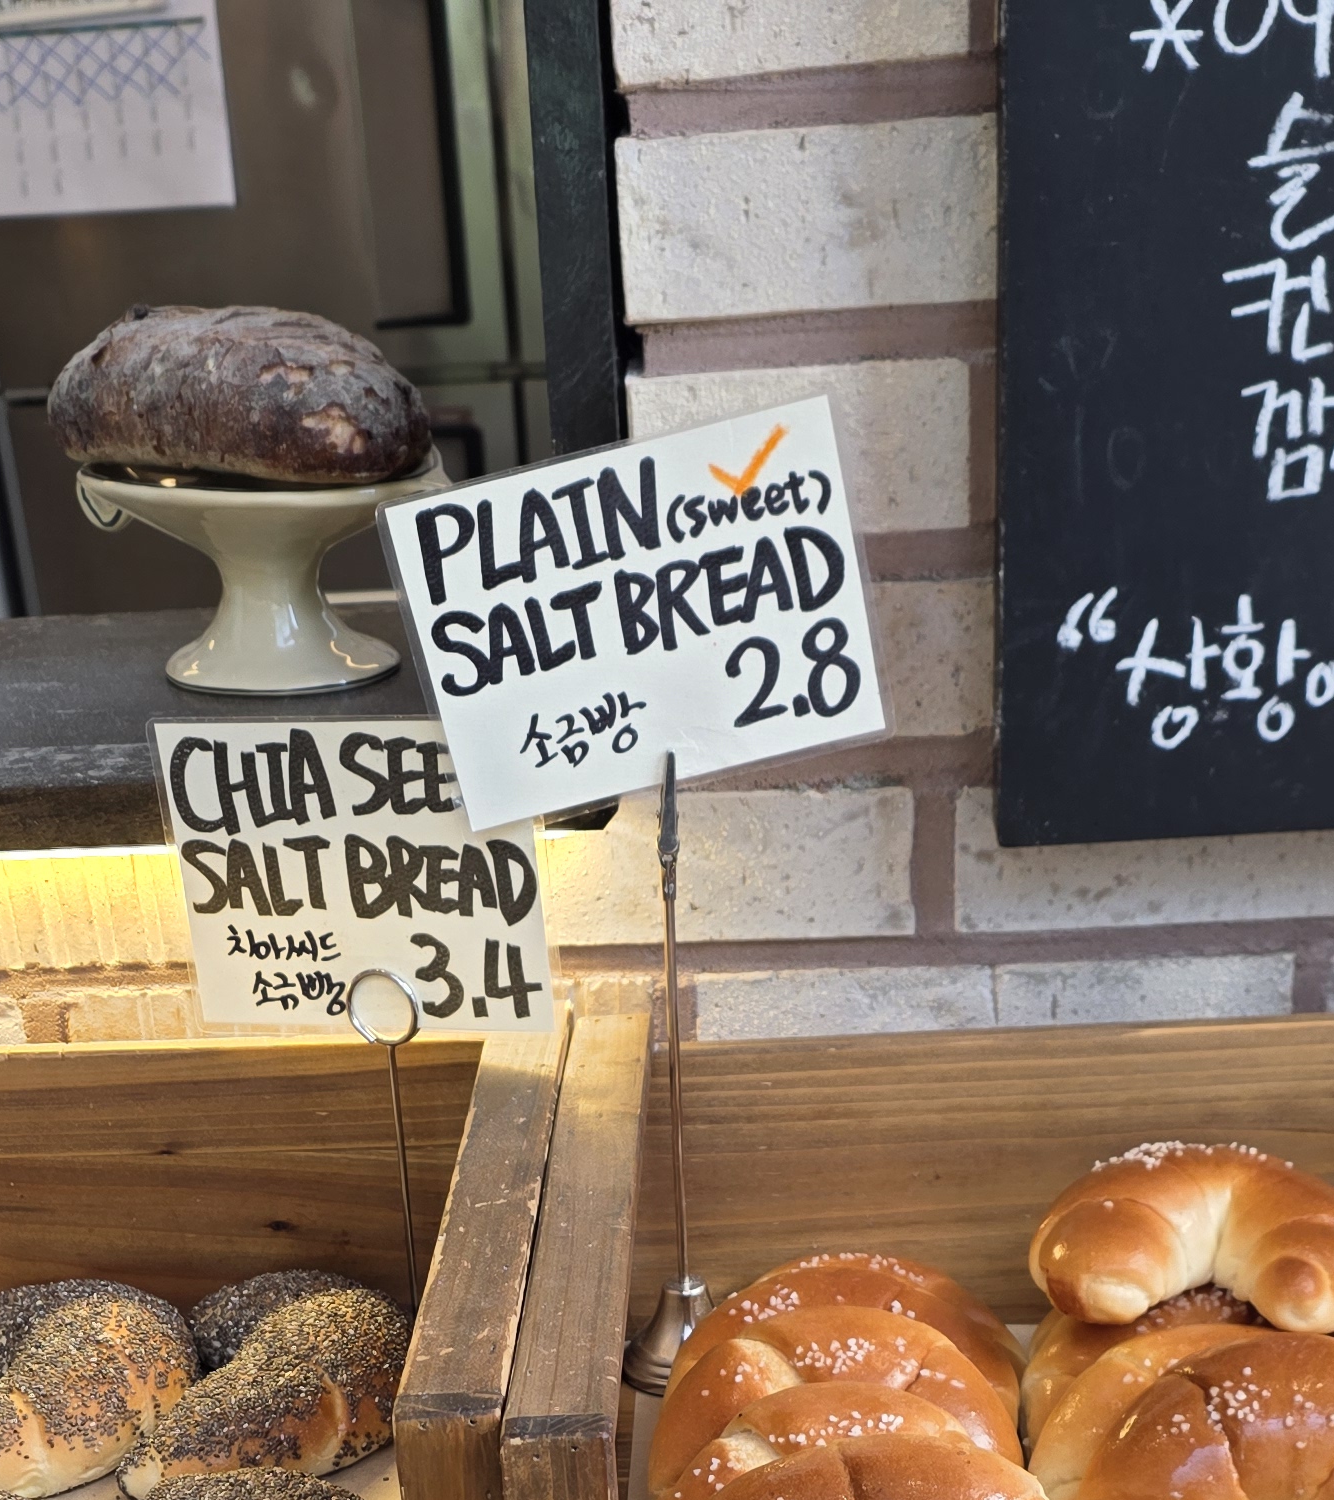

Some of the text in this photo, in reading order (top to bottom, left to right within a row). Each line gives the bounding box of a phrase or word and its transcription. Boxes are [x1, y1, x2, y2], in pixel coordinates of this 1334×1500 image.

[414, 456, 833, 606] PLAIN (sweet)
[430, 525, 846, 697] SALT BREAD
[725, 616, 862, 728] 2.8
[520, 691, 646, 768] 소금빵
[169, 728, 458, 836] CHIA SEE
[179, 833, 539, 927] SALT BREAD
[226, 924, 342, 963] 치아씨드
[410, 932, 543, 1019] 3.4
[252, 970, 347, 1017] 소금빵
